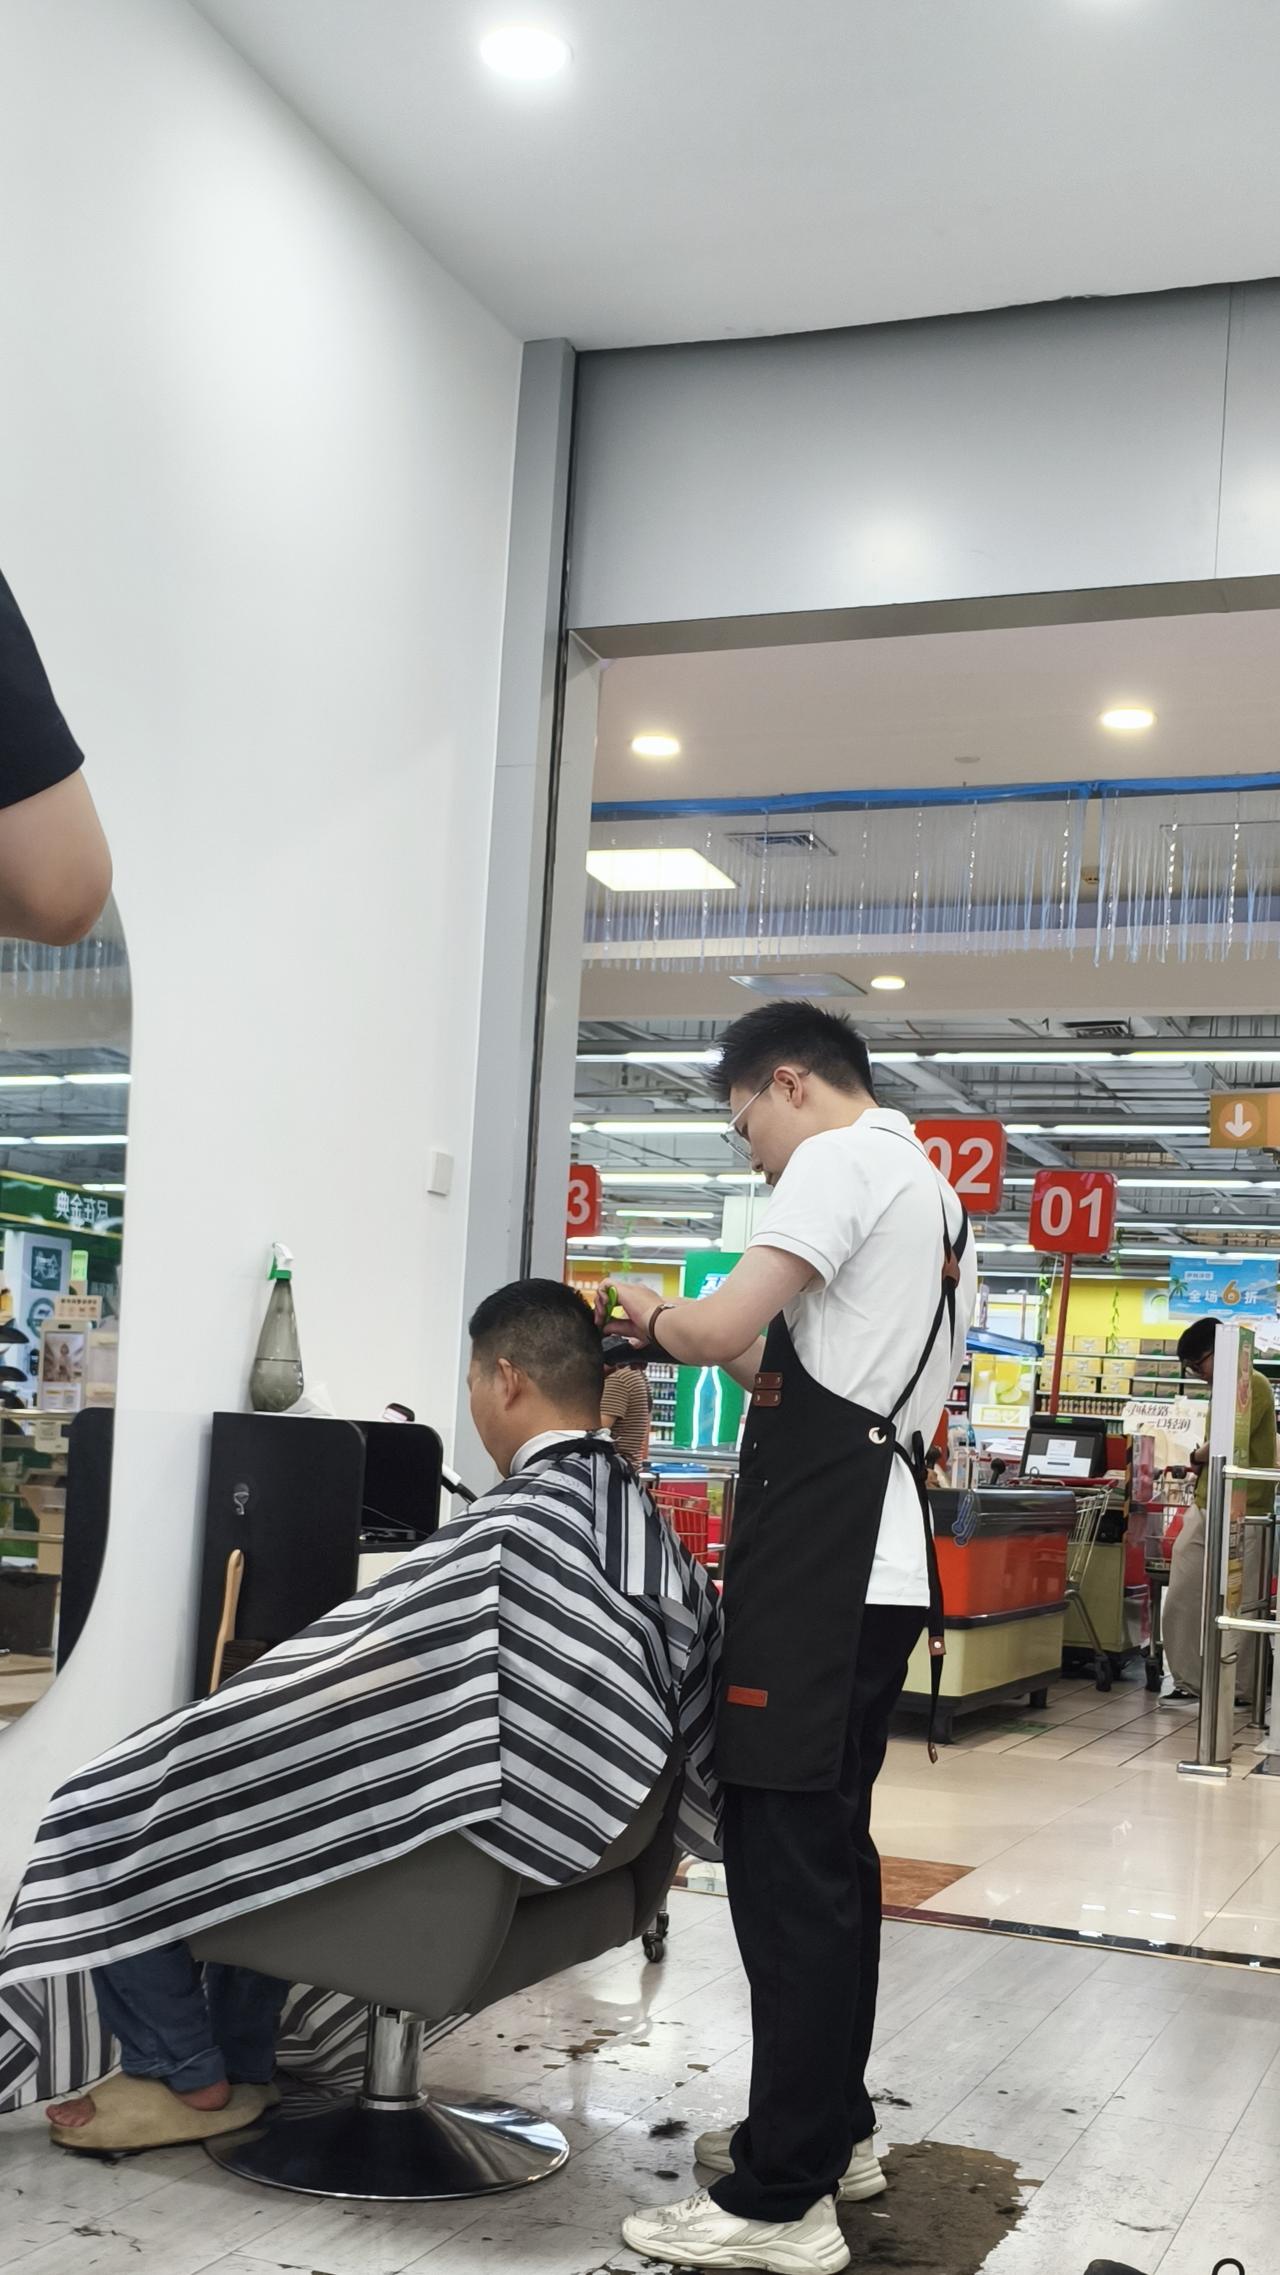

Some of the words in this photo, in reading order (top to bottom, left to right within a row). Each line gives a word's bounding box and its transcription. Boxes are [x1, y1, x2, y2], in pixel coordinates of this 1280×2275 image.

[923, 1137, 994, 1194] 02
[1041, 1186, 1103, 1238] 01
[1188, 1280, 1258, 1305] 全场6折
